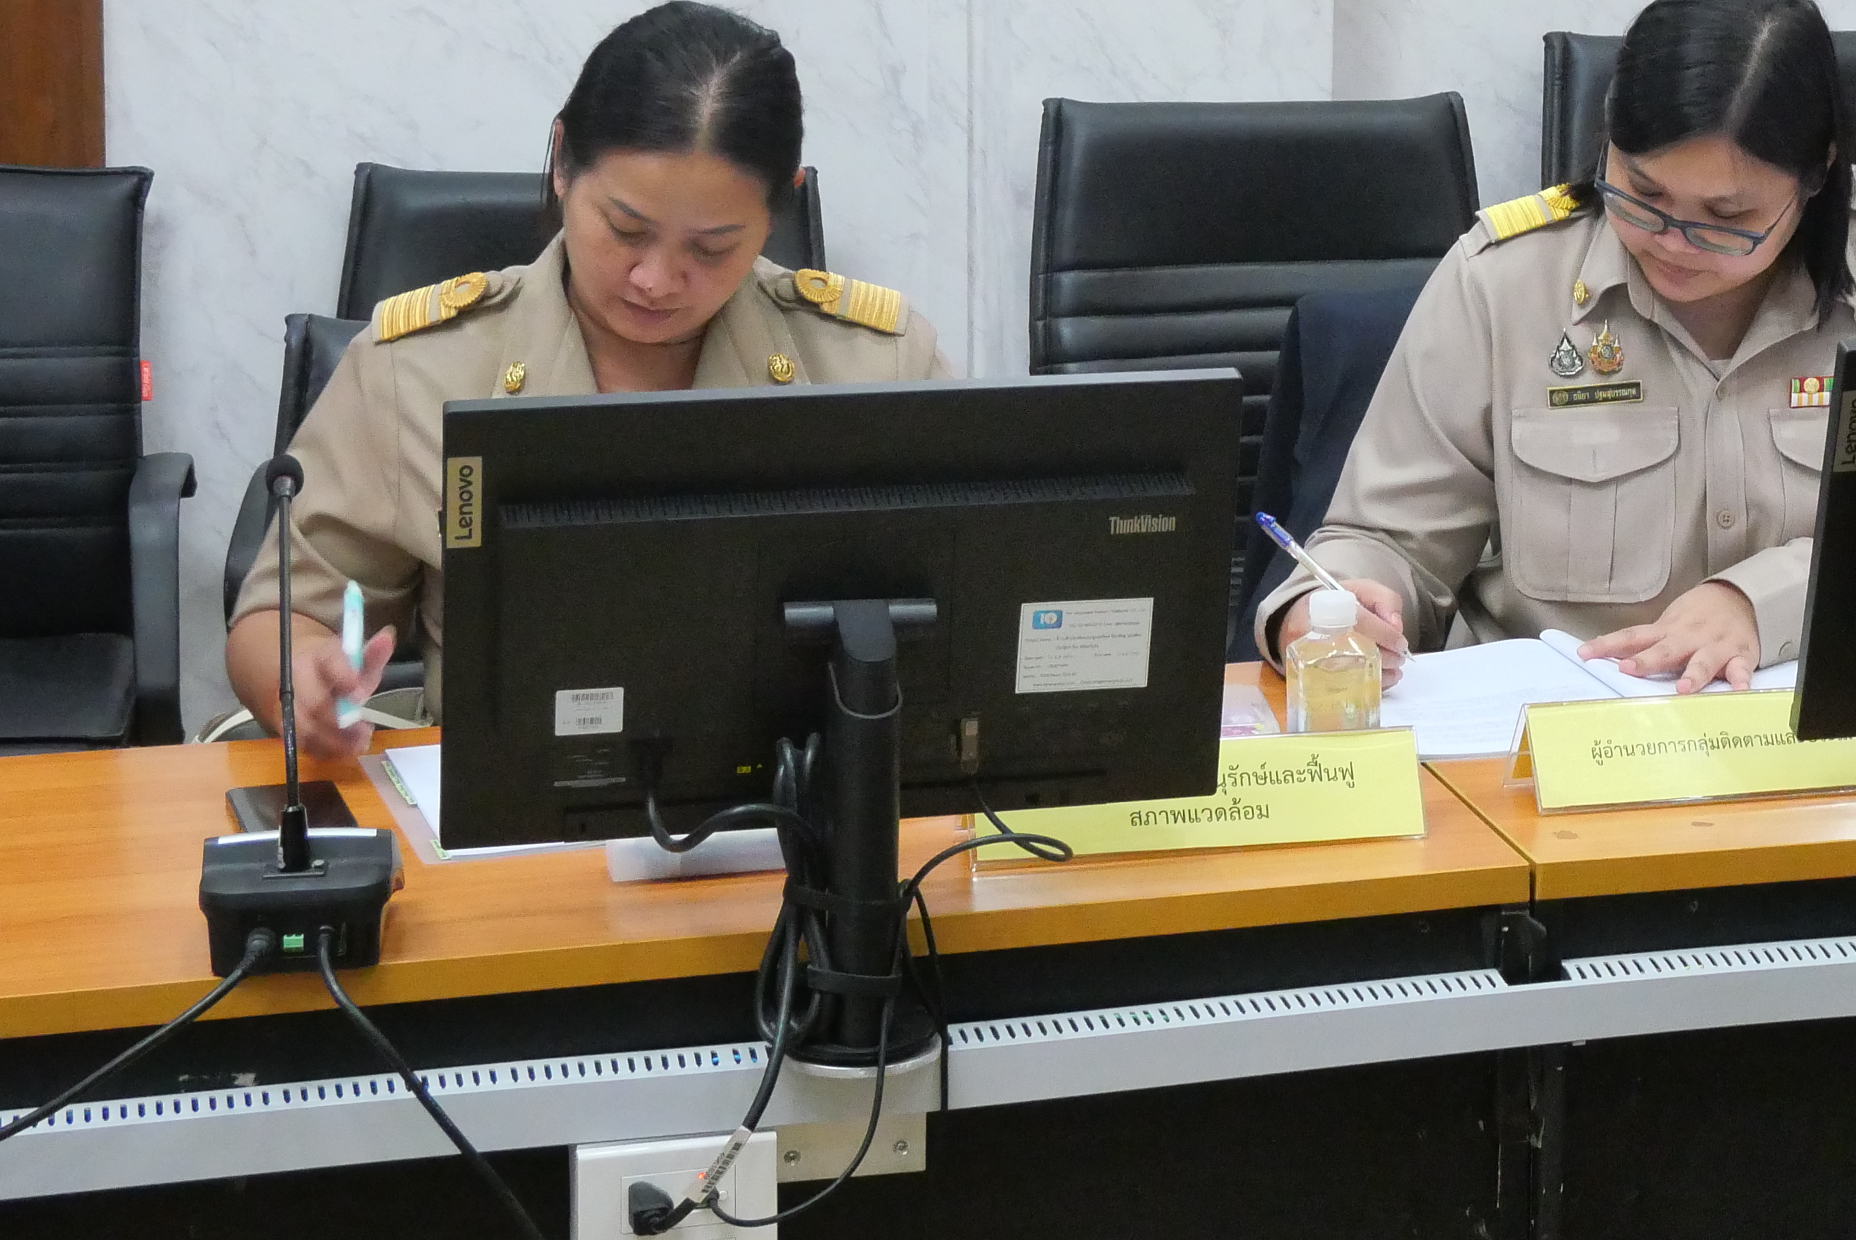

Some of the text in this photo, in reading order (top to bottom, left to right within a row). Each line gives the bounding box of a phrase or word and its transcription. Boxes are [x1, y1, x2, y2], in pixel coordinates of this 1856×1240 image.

[454, 464, 474, 541] Lenovo
[1109, 513, 1176, 535] ThinkVision
[1129, 798, 1270, 828] สภาพแวดล้อม
